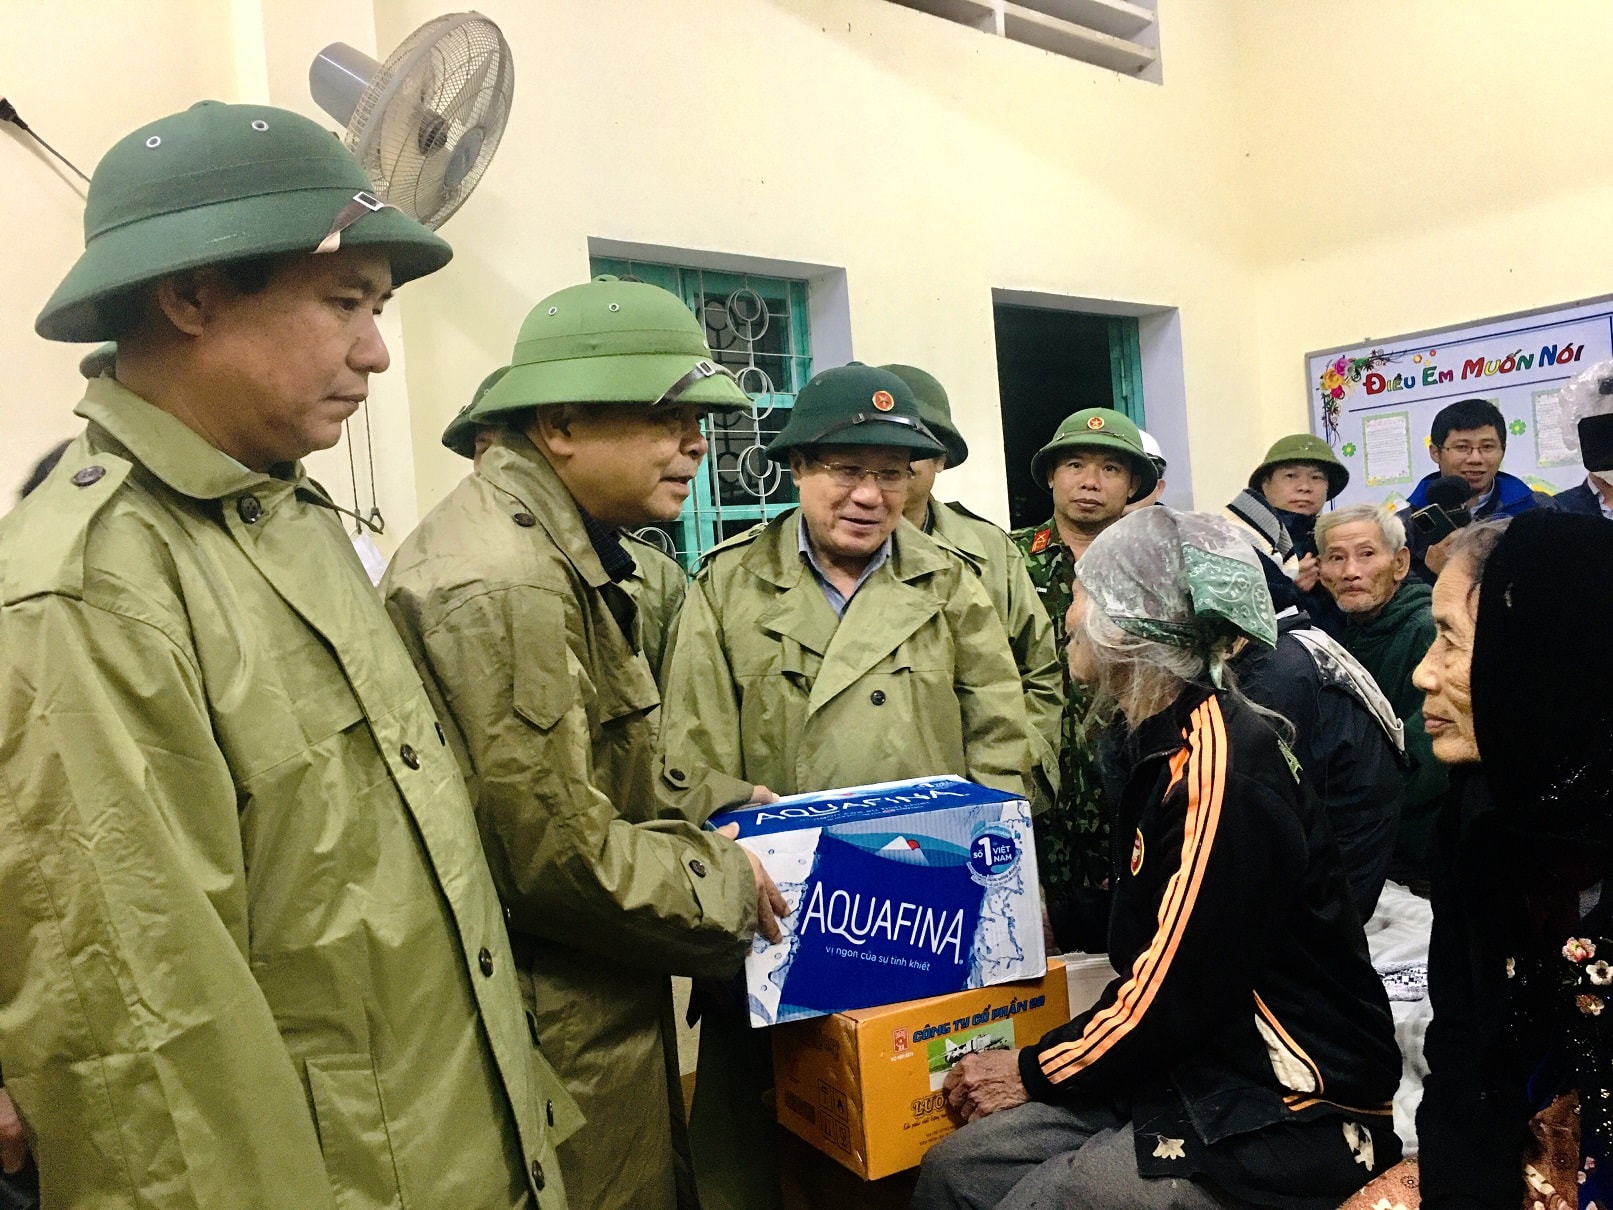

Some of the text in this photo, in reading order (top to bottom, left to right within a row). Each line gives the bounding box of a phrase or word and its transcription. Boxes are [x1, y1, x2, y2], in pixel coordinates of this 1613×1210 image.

[1461, 349, 1535, 380] MUỐN
[1539, 342, 1585, 367] NÓI
[755, 788, 965, 826] AQUAFINA
[978, 837, 993, 866] 1
[993, 854, 1013, 863] NAM
[800, 880, 964, 965] AQUAFINA
[860, 950, 877, 962] của
[908, 959, 931, 971] khiết
[912, 1023, 951, 1043] CÔNG
